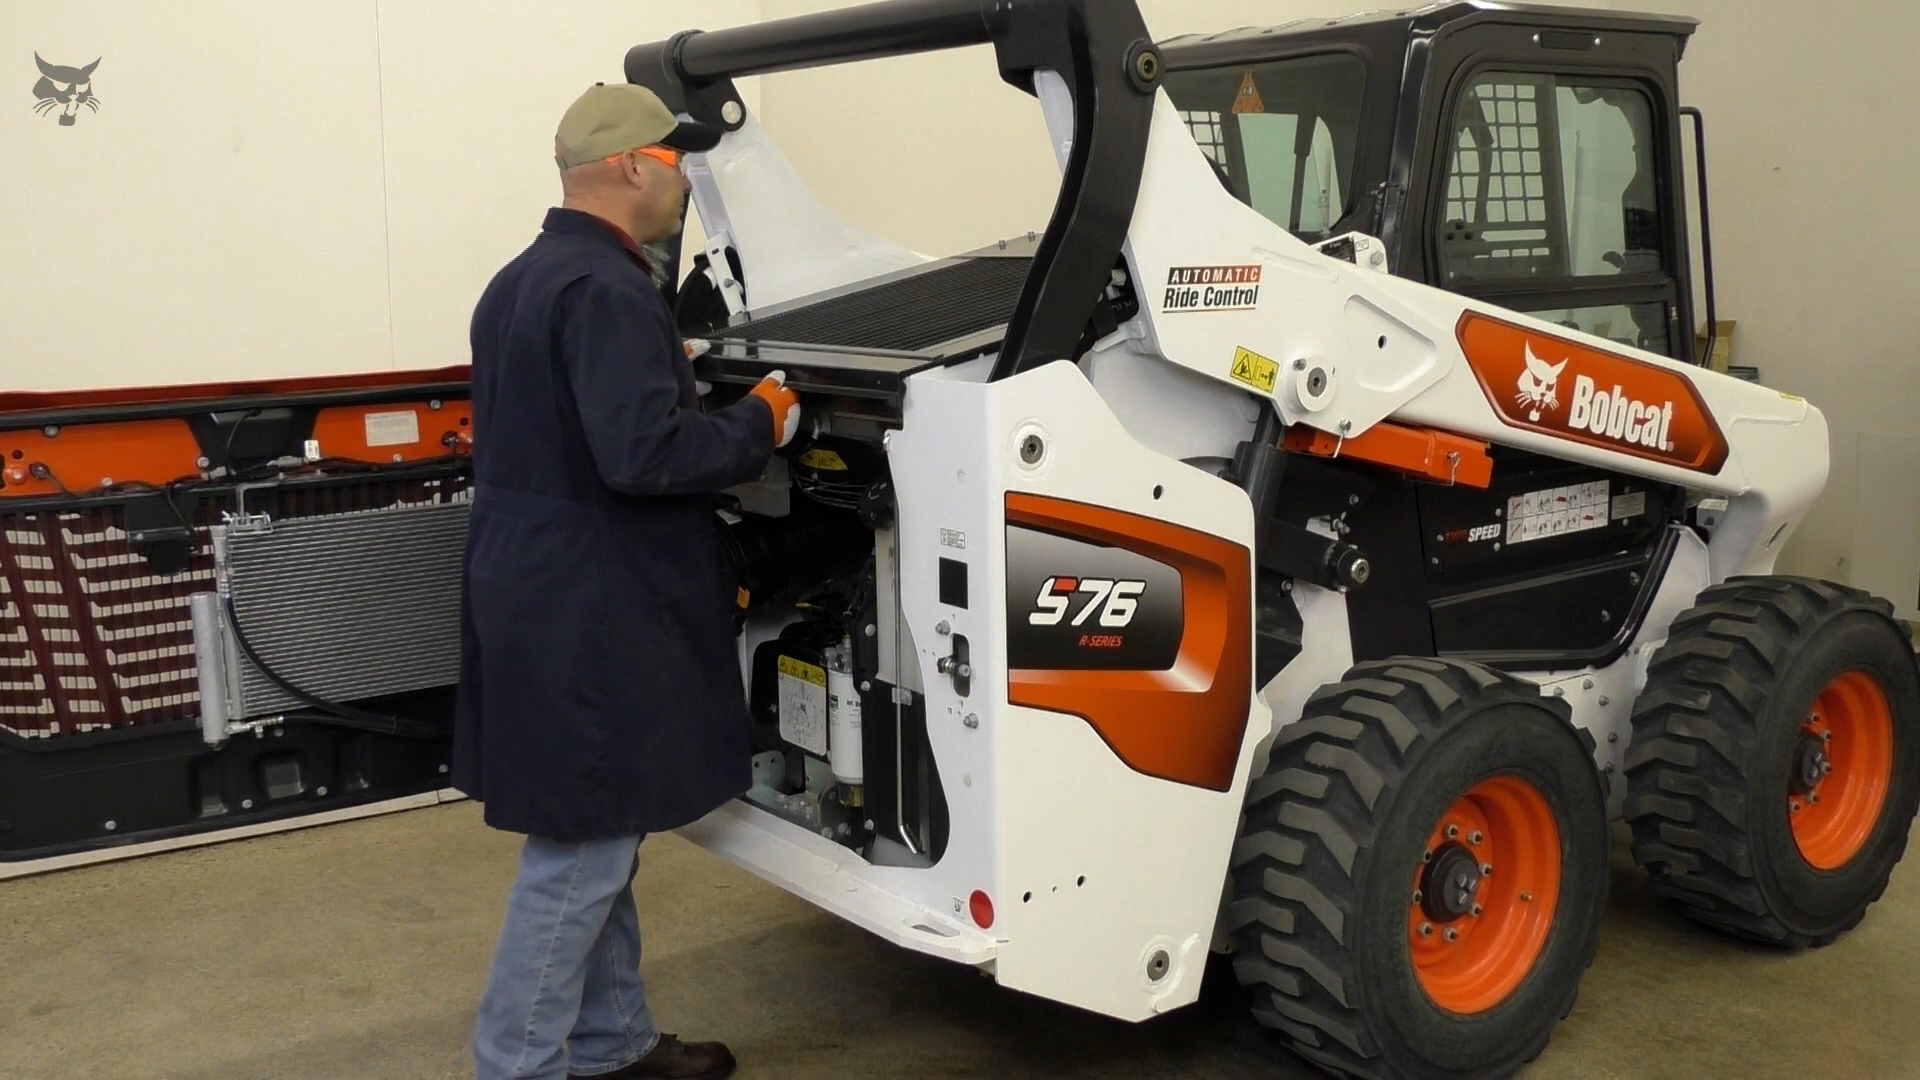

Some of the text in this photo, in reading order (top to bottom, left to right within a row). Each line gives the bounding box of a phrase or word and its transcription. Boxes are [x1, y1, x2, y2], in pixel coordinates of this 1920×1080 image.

[1171, 267, 1258, 283] AUTOMATIC
[1163, 285, 1259, 308] Ride Control
[1568, 374, 1673, 451] Bobcat
[1468, 523, 1501, 542] SPEED
[1028, 577, 1146, 627] S76
[1079, 635, 1123, 647] R-SERIES
